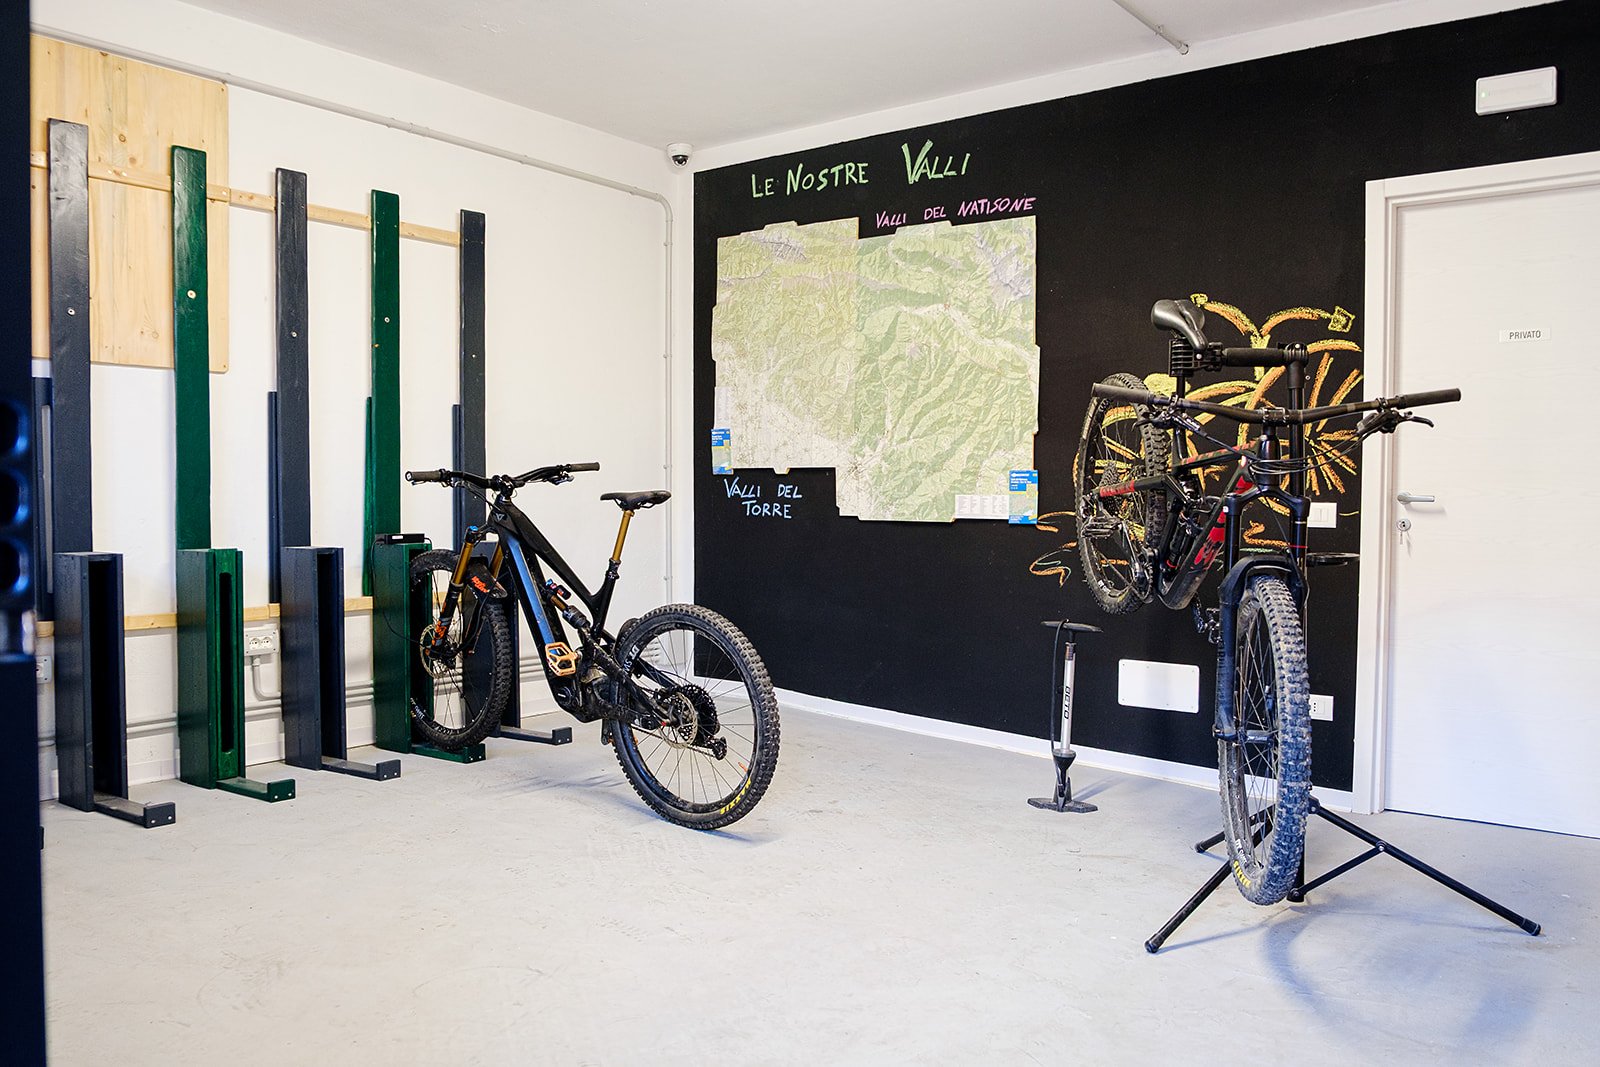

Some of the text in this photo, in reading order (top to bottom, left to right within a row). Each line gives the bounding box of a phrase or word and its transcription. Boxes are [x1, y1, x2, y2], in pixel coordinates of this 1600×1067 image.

[751, 139, 970, 198] LE NOSTRE VALLI
[875, 196, 1037, 229] VALLI DEL NATISONE
[1509, 330, 1541, 340] PRIVATO
[724, 476, 803, 499] VALLI DEL
[741, 499, 792, 519] TORRE
